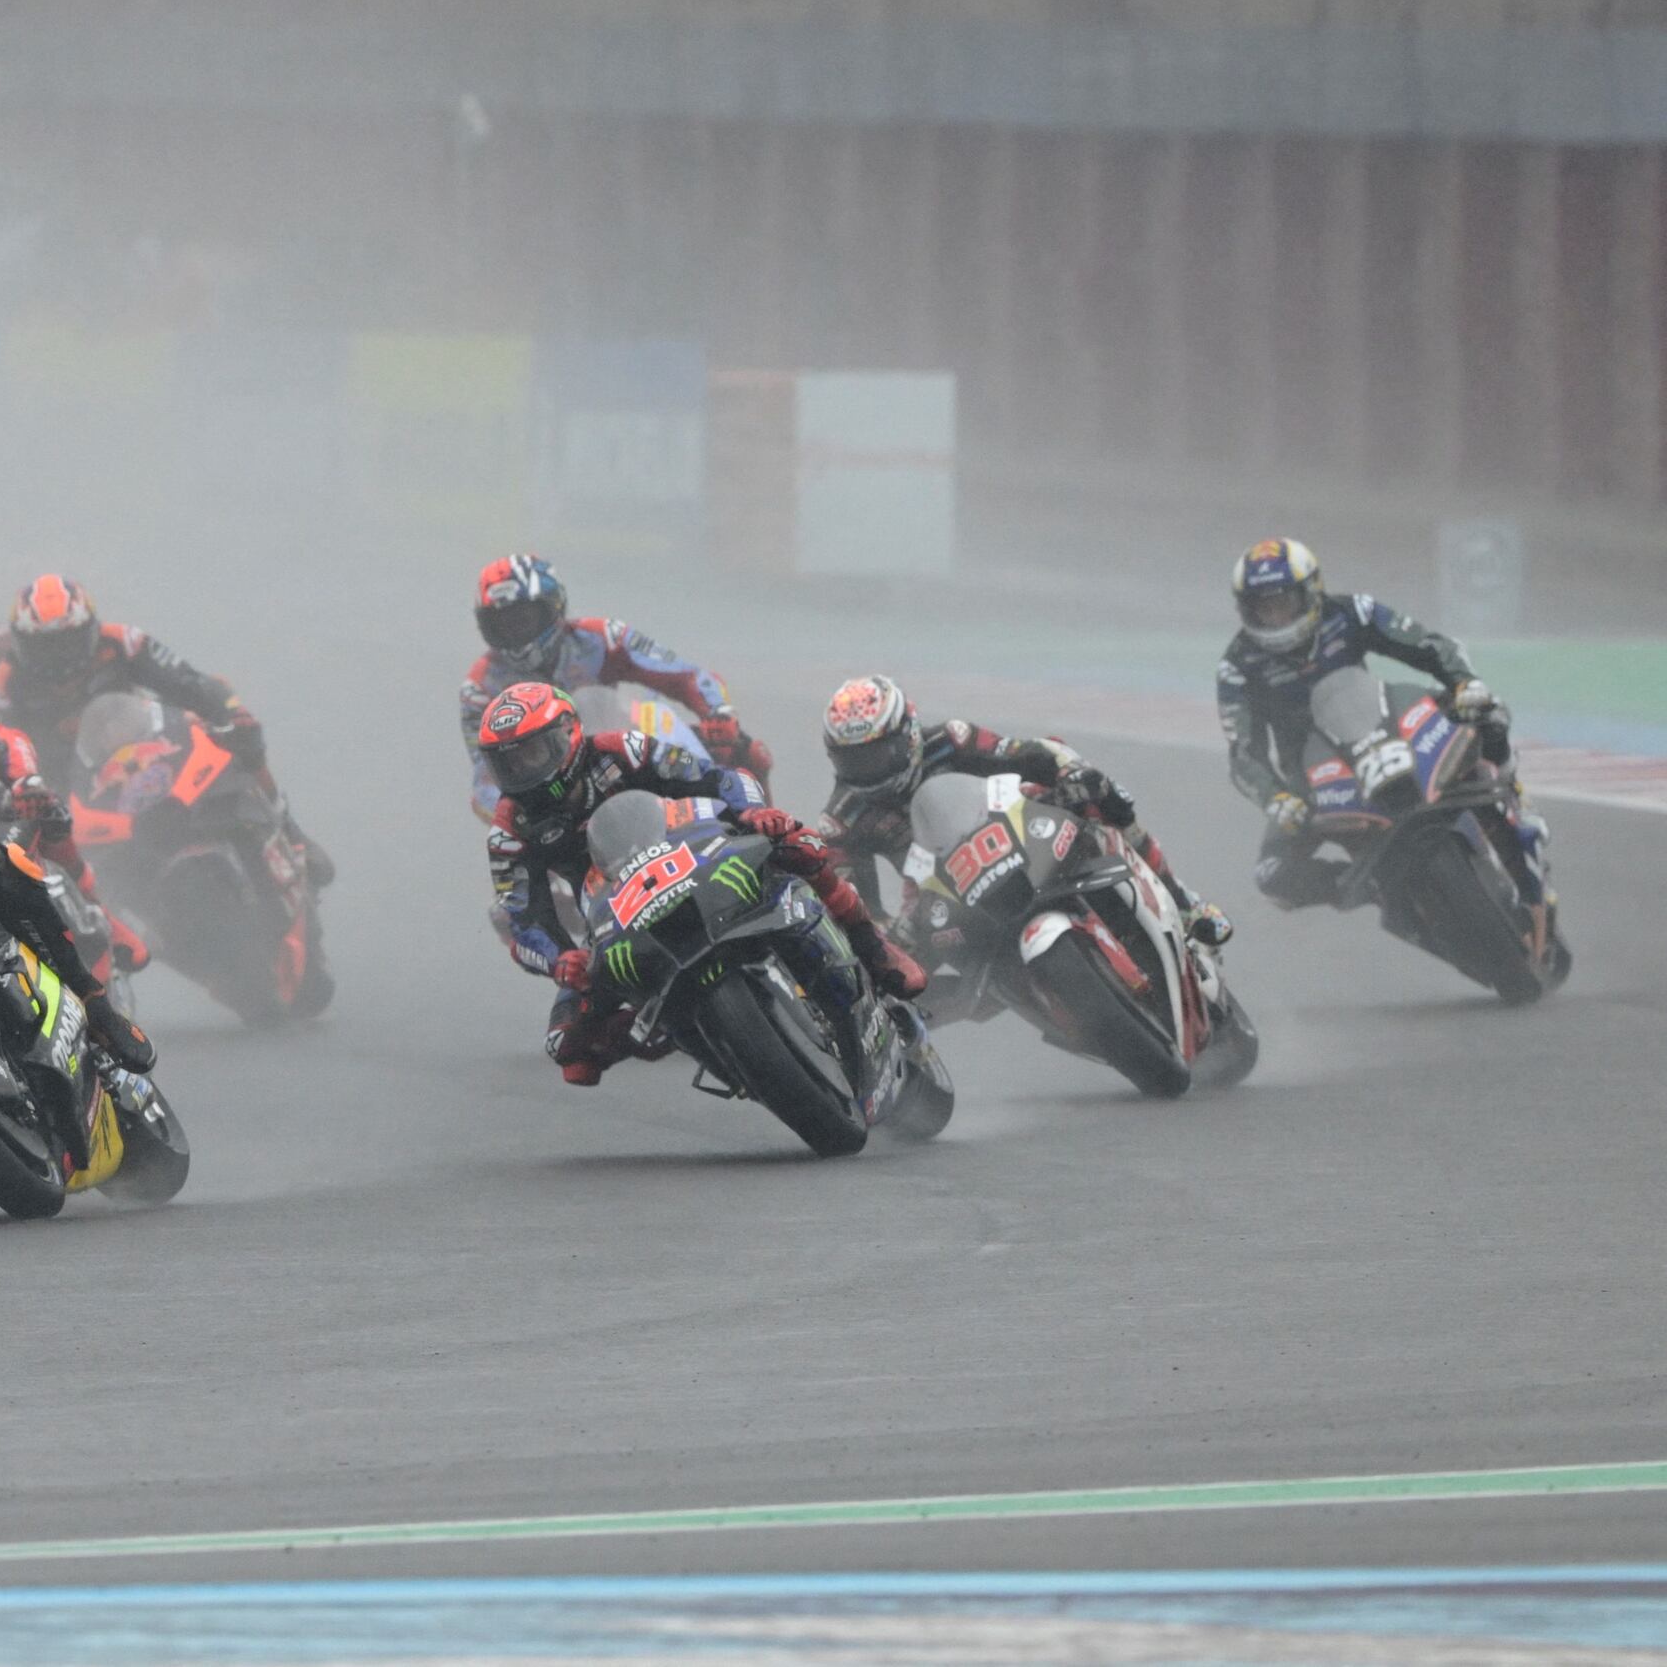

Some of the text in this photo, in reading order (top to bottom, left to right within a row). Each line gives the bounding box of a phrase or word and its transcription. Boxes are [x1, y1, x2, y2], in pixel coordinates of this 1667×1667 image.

[1355, 739, 1413, 800] 25
[609, 841, 698, 930] 20
[619, 840, 673, 883] ENEOS
[945, 821, 1013, 897] 30
[967, 852, 1024, 908] CUSTOM
[632, 878, 698, 932] MONSTER
